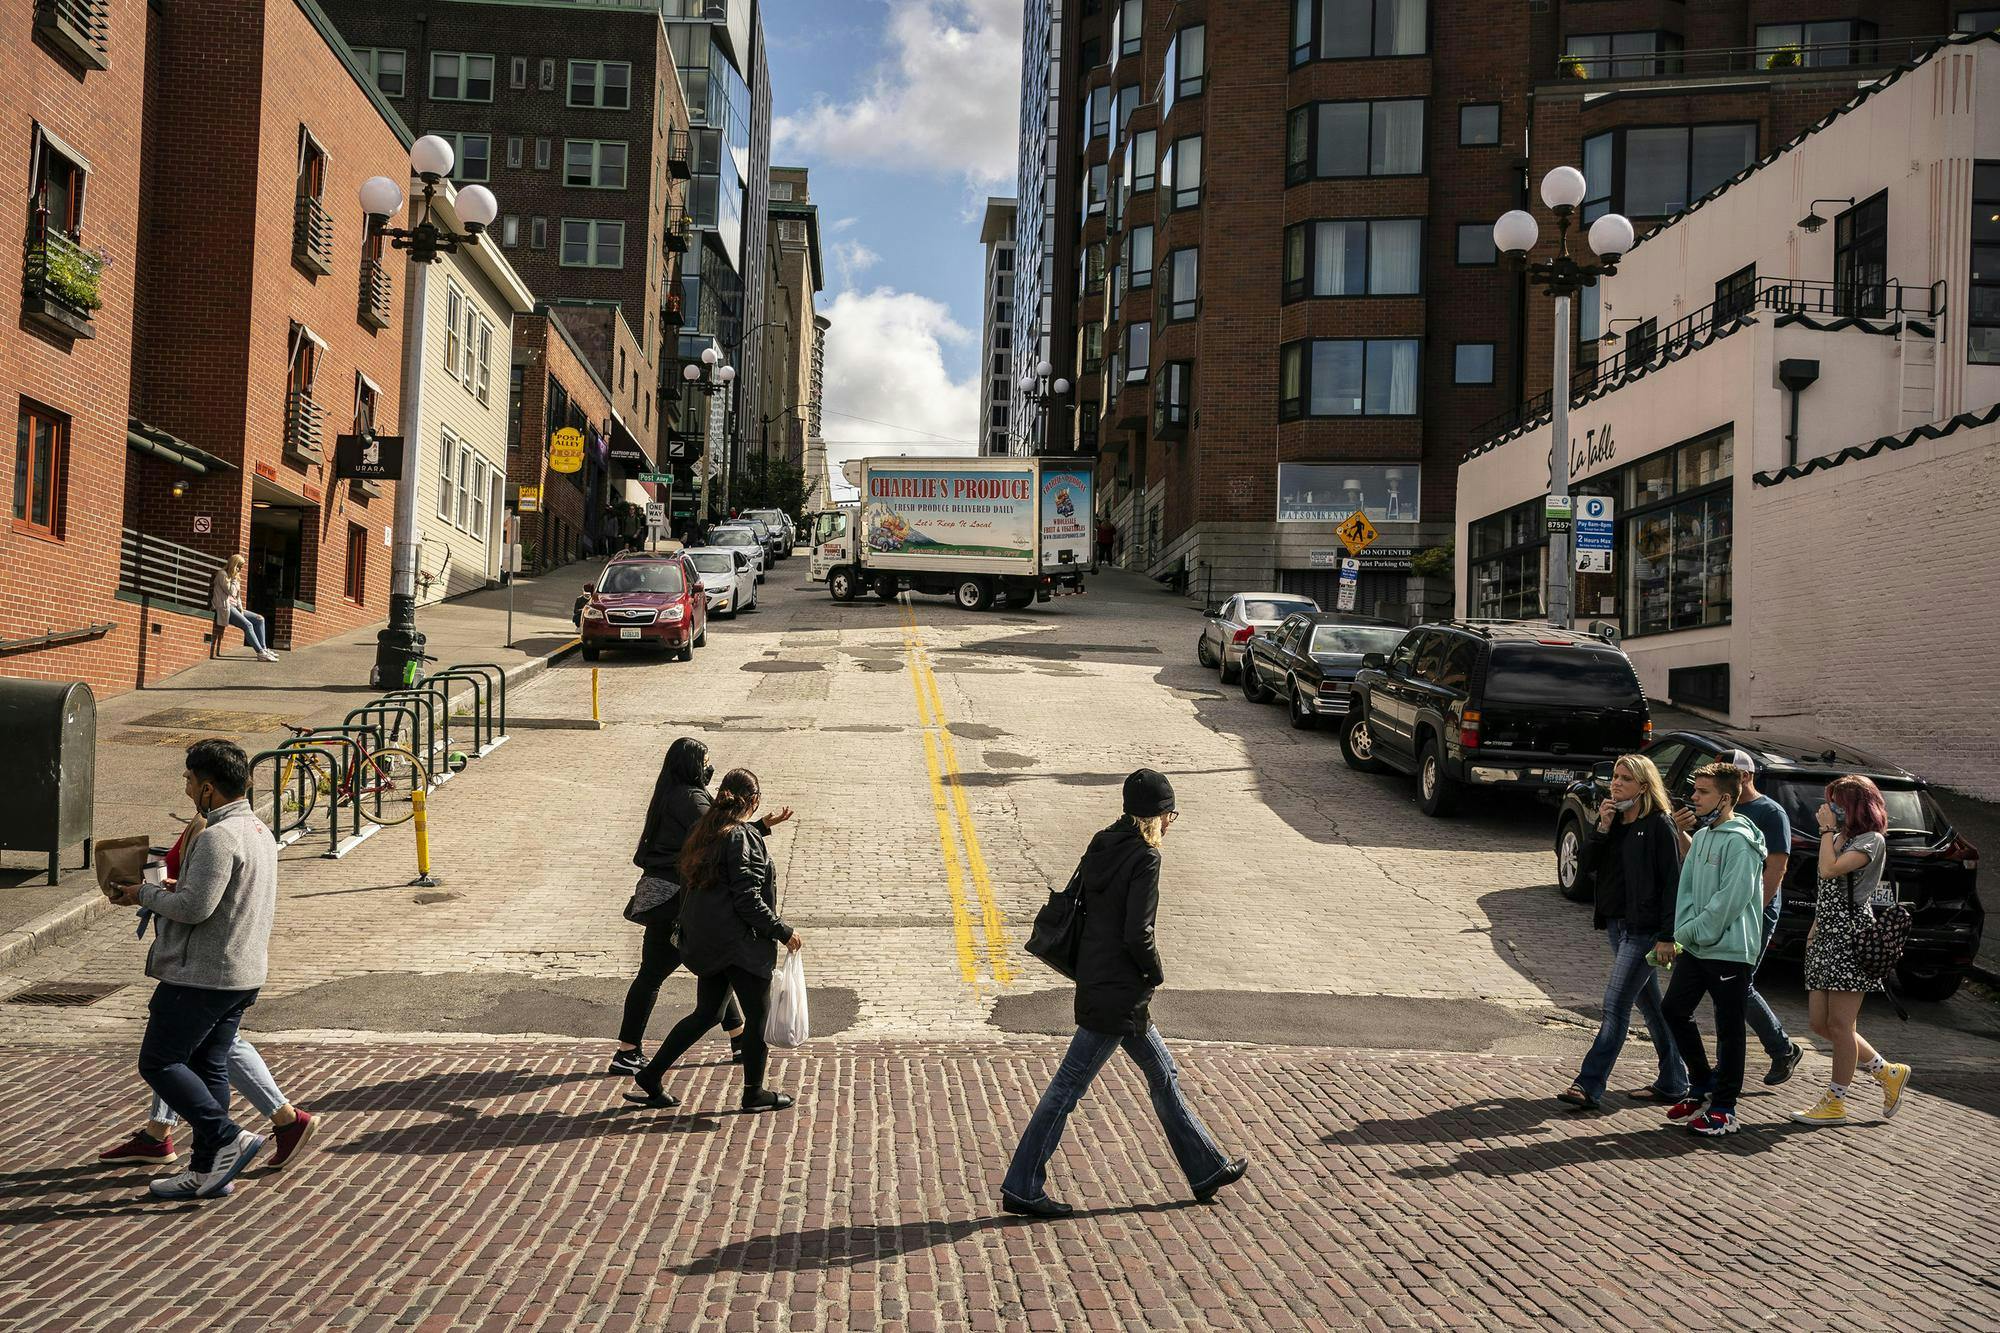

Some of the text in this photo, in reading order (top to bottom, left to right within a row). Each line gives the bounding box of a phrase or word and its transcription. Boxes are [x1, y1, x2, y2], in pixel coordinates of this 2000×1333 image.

[1570, 438, 1587, 478] La
[1587, 424, 1616, 472] Table
[871, 478, 1030, 500] CHARLIE'S PRODUCE
[952, 505, 990, 513] DELIVERED
